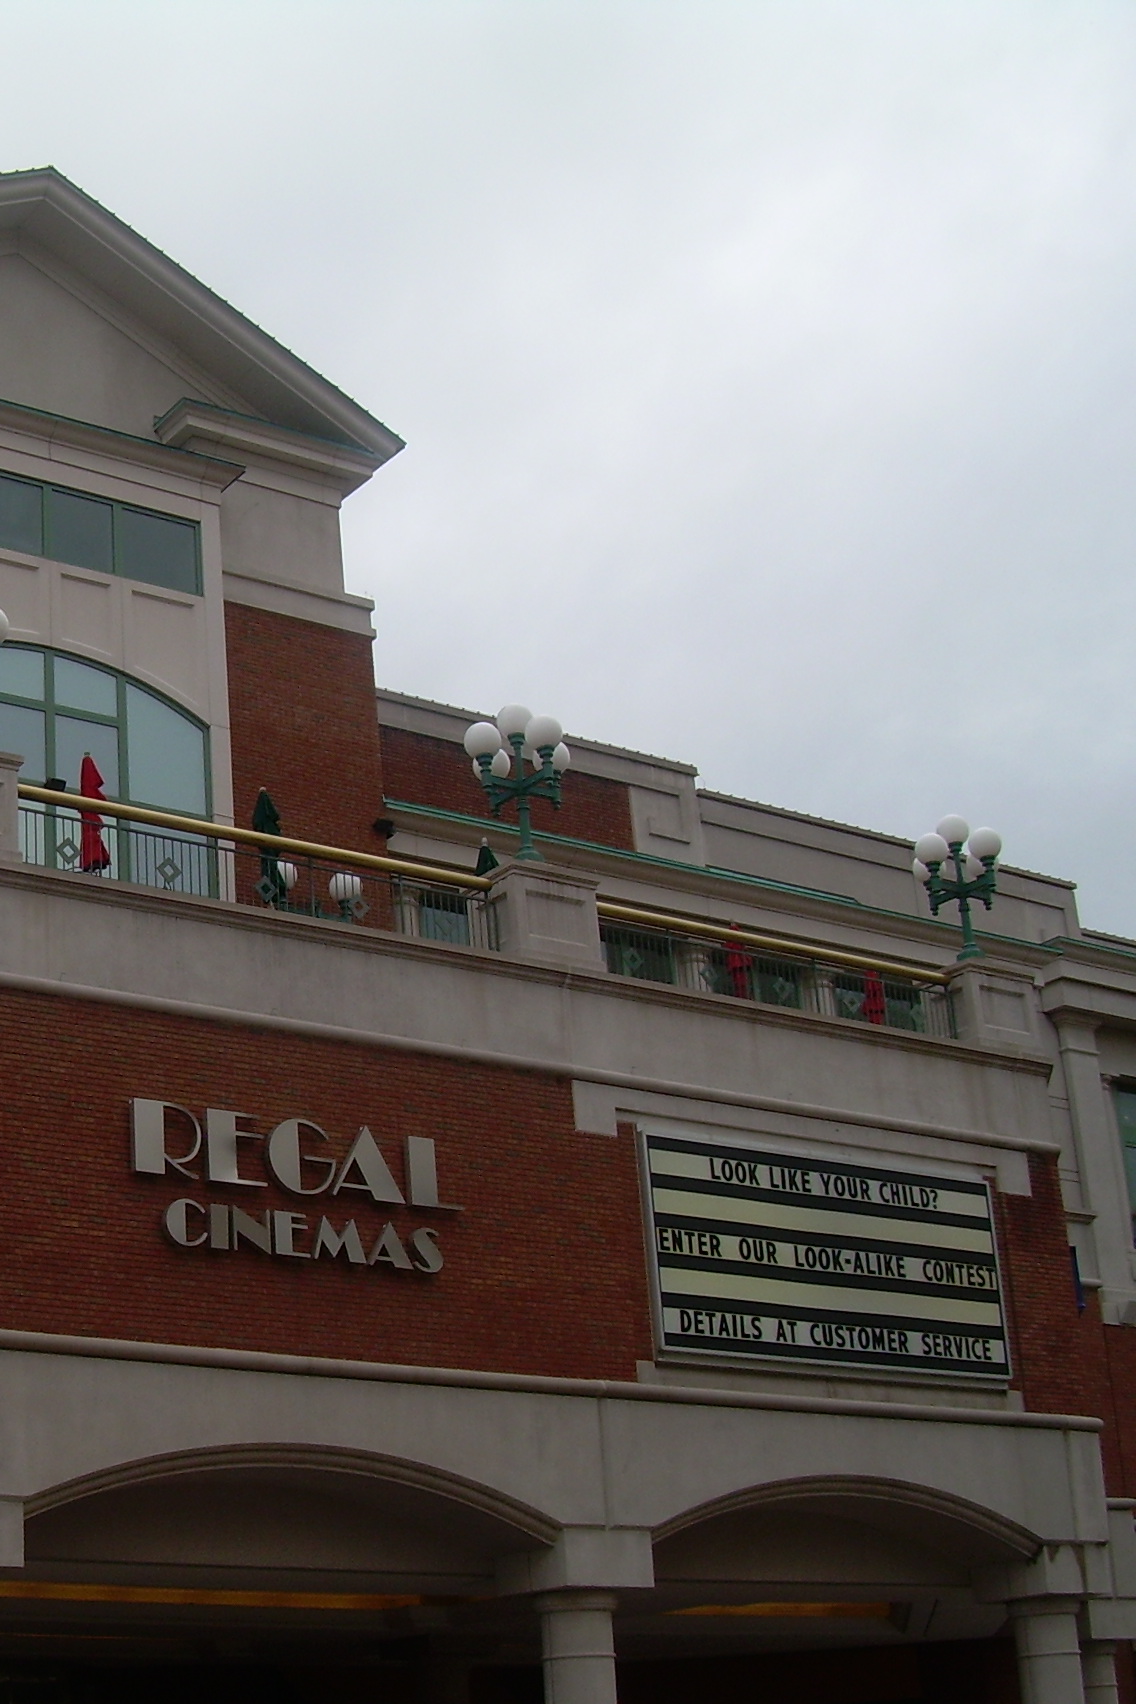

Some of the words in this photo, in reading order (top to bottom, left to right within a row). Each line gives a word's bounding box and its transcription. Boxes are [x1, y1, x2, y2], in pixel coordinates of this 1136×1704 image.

[128, 1097, 466, 1211] REGAL
[710, 1158, 759, 1187] LOOK
[769, 1166, 811, 1193] LIKE
[819, 1172, 871, 1201] YOUR
[879, 1182, 939, 1210] CHILD?
[163, 1197, 444, 1274] CINEMAS
[658, 1227, 721, 1258] ENTER
[739, 1237, 778, 1264] OUR
[794, 1244, 907, 1278] LOOK-ALIKE
[922, 1260, 996, 1289] CONTEST
[679, 1310, 762, 1339] DETAILS
[776, 1319, 797, 1344] AT
[810, 1323, 909, 1353] CUSTOMER
[922, 1333, 992, 1360] SERVICE
